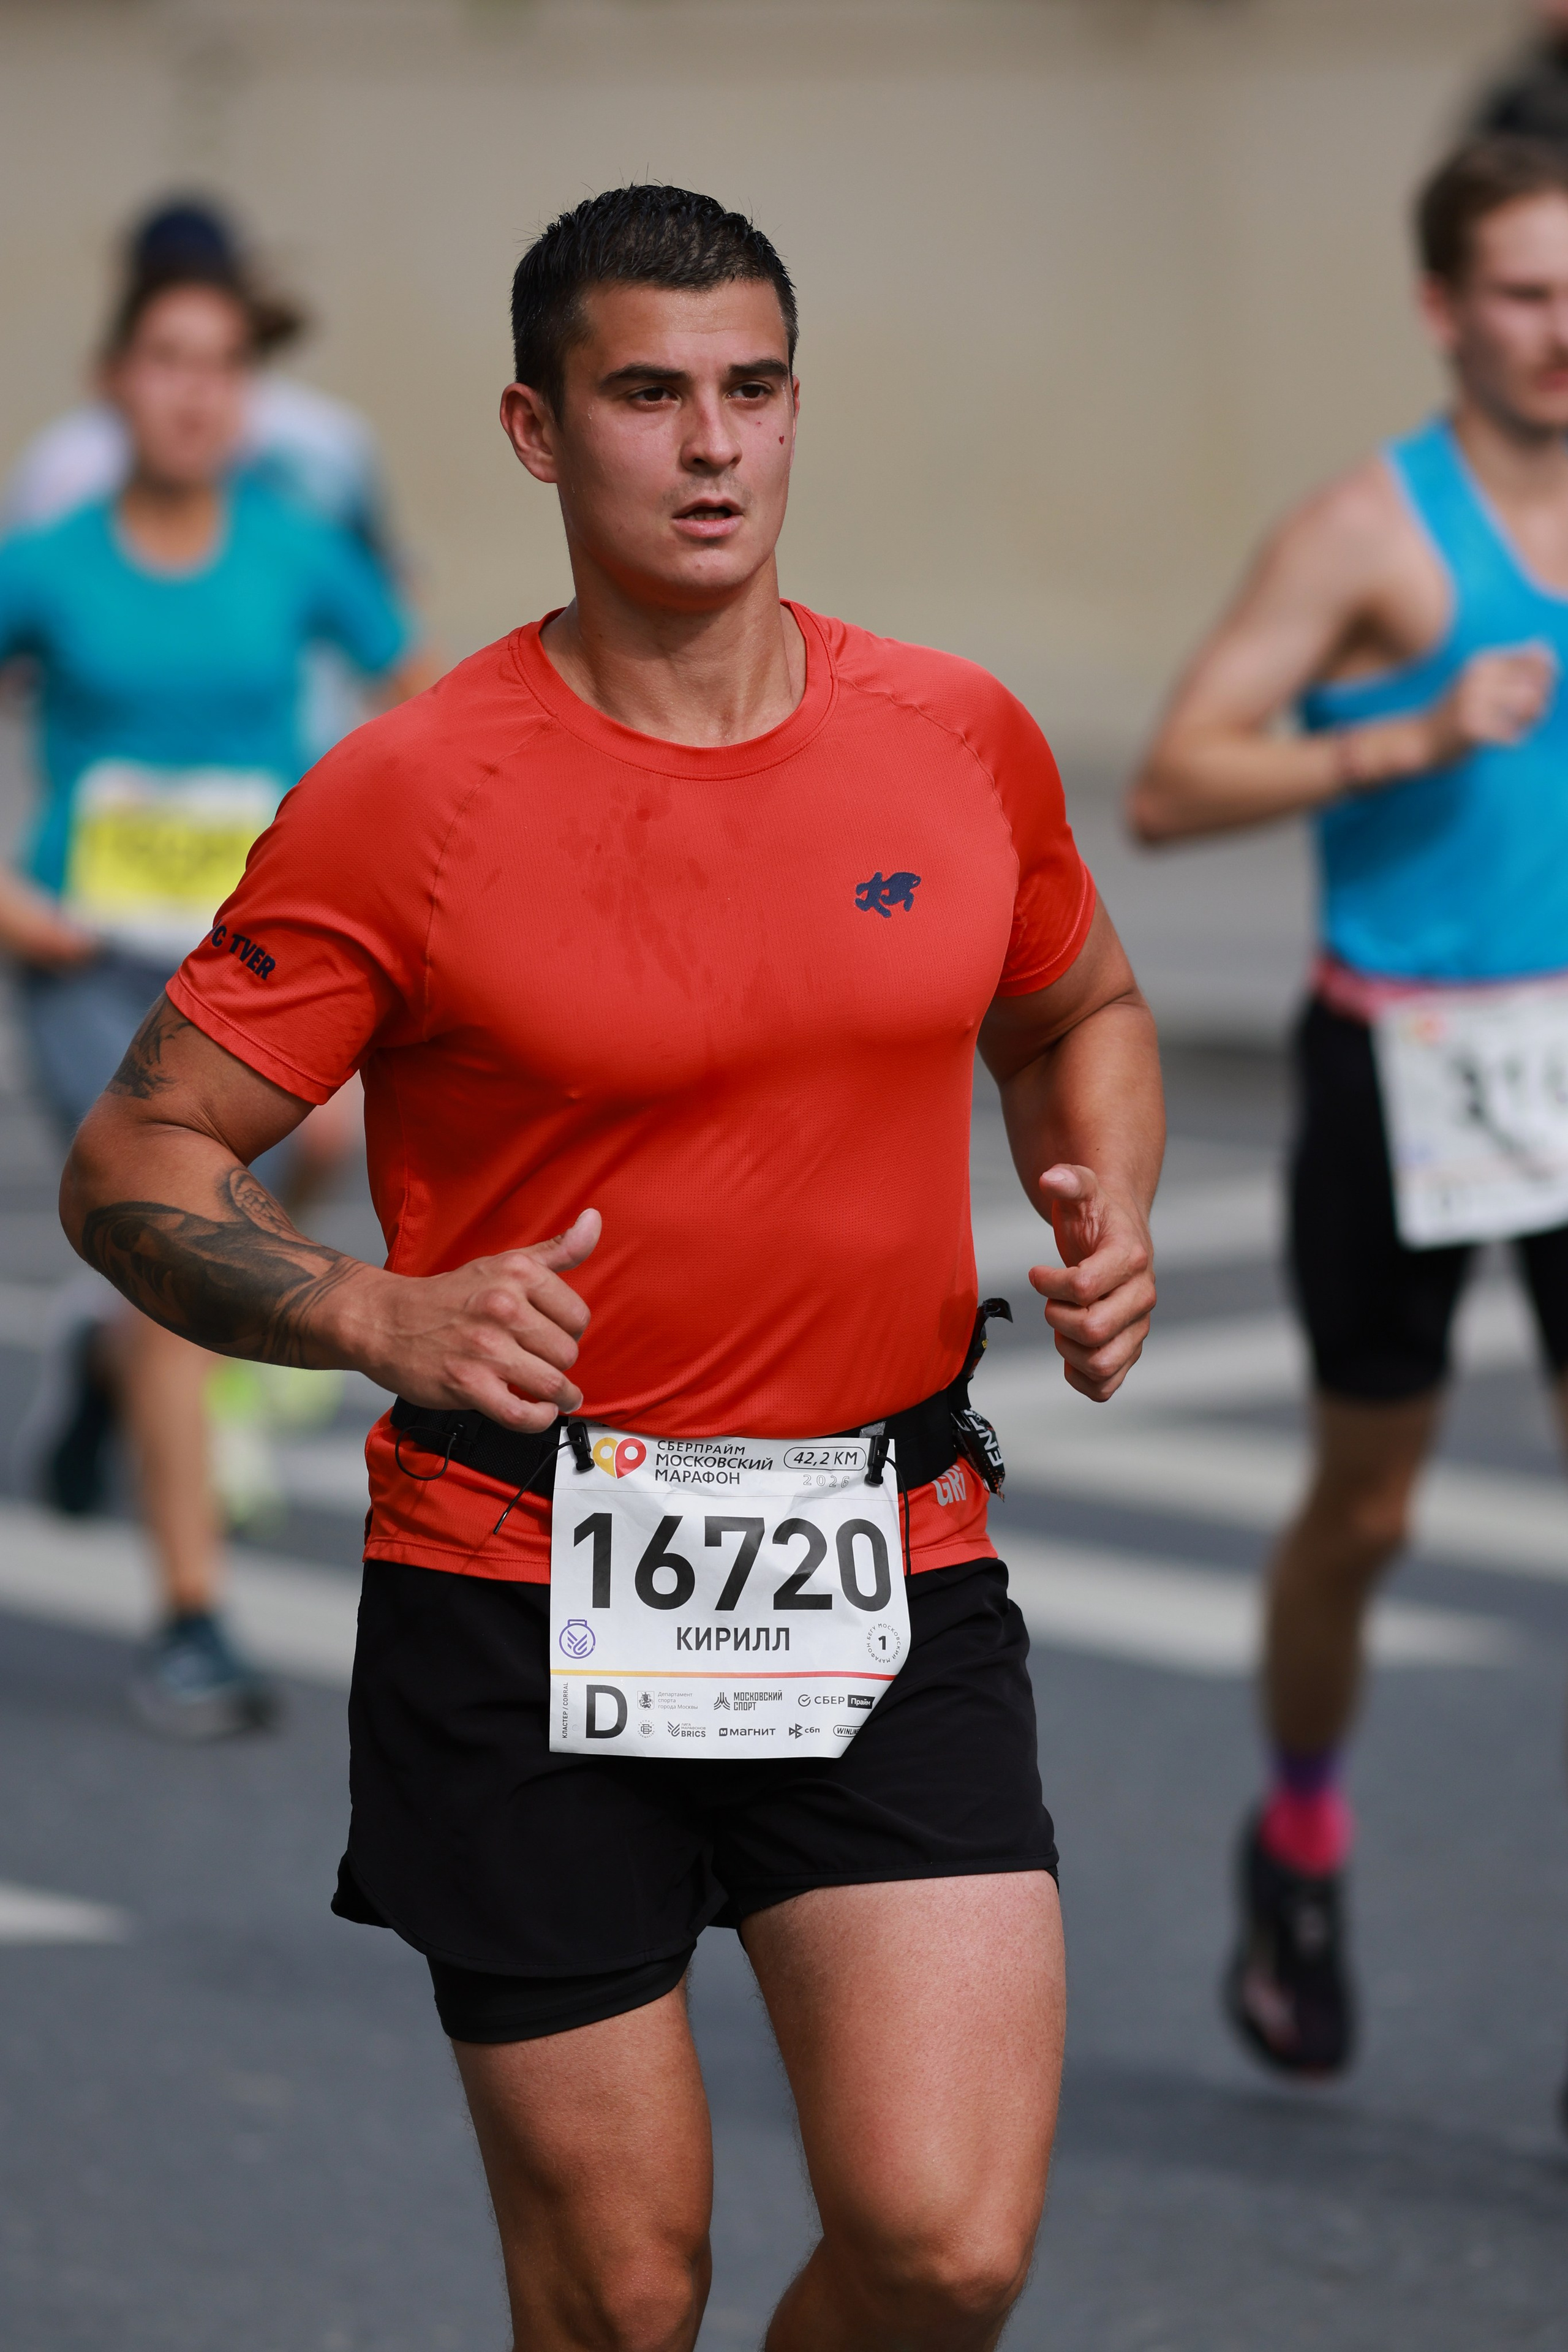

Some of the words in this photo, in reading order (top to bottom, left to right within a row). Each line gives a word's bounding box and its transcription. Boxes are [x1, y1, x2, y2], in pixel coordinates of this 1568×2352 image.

[229, 933, 276, 981] TVER
[657, 1440, 745, 1455] СБЕРПРАЙМ
[655, 1453, 773, 1471] МОСКОВСКИЙ
[793, 1452, 830, 1466] 42,2
[834, 1451, 858, 1465] КМ
[655, 1469, 740, 1485] МАРАФОН
[802, 1474, 850, 1488] 2026
[573, 1512, 892, 1612] 16720
[676, 1627, 790, 1651] КИРИЛЛ
[866, 1626, 876, 1640] БЕГУ
[878, 1623, 901, 1660] МОСКОВСКИЙ
[878, 1635, 886, 1650] 1
[866, 1643, 891, 1664] МАРАФОН
[734, 1690, 782, 1701] МОСКОВСКИЙ
[814, 1696, 845, 1705] СБЕР
[851, 1697, 871, 1706] Прайм
[586, 1684, 628, 1739] D
[734, 1702, 756, 1711] СПОРТ
